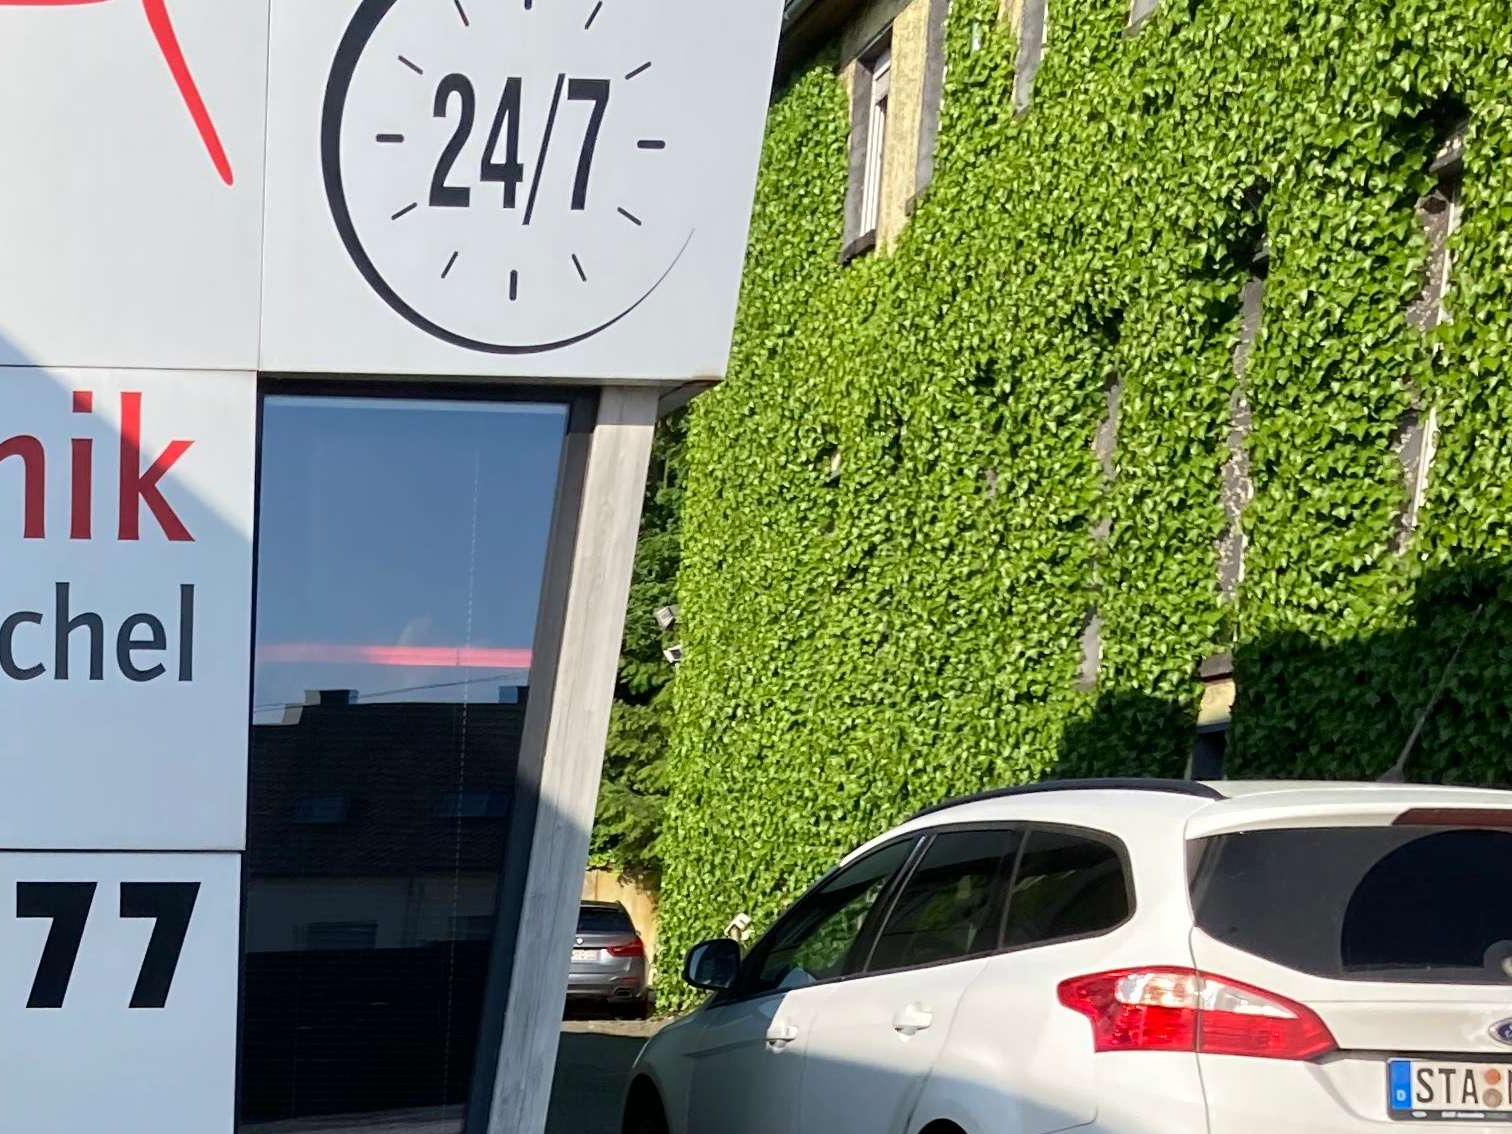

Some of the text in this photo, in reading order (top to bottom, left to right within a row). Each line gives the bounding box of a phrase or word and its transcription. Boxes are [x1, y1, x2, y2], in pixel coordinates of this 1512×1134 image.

[428, 73, 611, 226] 24/7
[15, 881, 202, 1009] 77
[1396, 1089, 1407, 1102] D
[1415, 1067, 1479, 1105] STA
